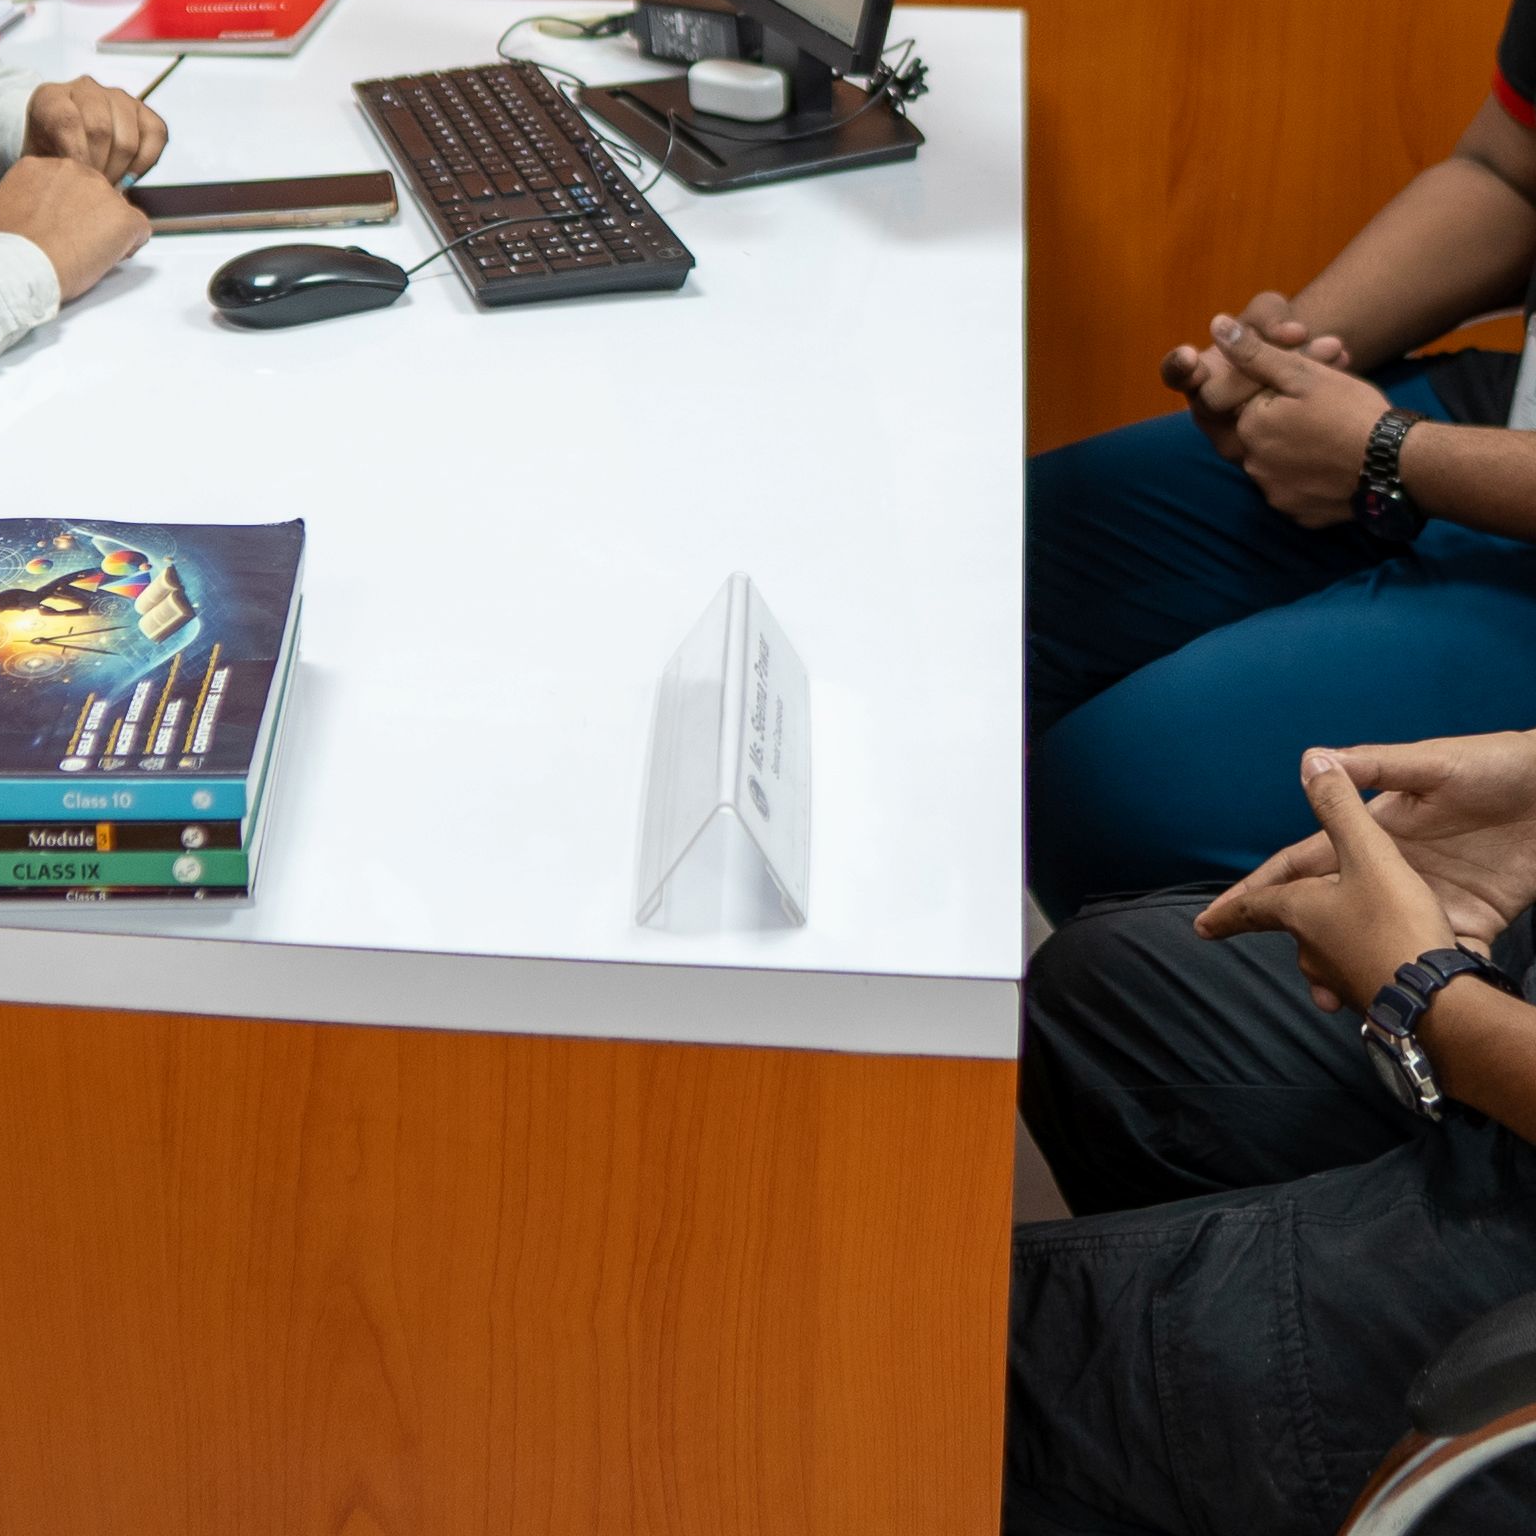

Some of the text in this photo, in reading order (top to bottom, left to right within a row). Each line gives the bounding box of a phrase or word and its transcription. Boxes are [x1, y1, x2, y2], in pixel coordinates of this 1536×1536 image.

[62, 790, 109, 809] Class
[111, 791, 134, 809] 10
[28, 829, 96, 847] Module
[12, 863, 77, 881] CLASS
[80, 862, 101, 880] IX
